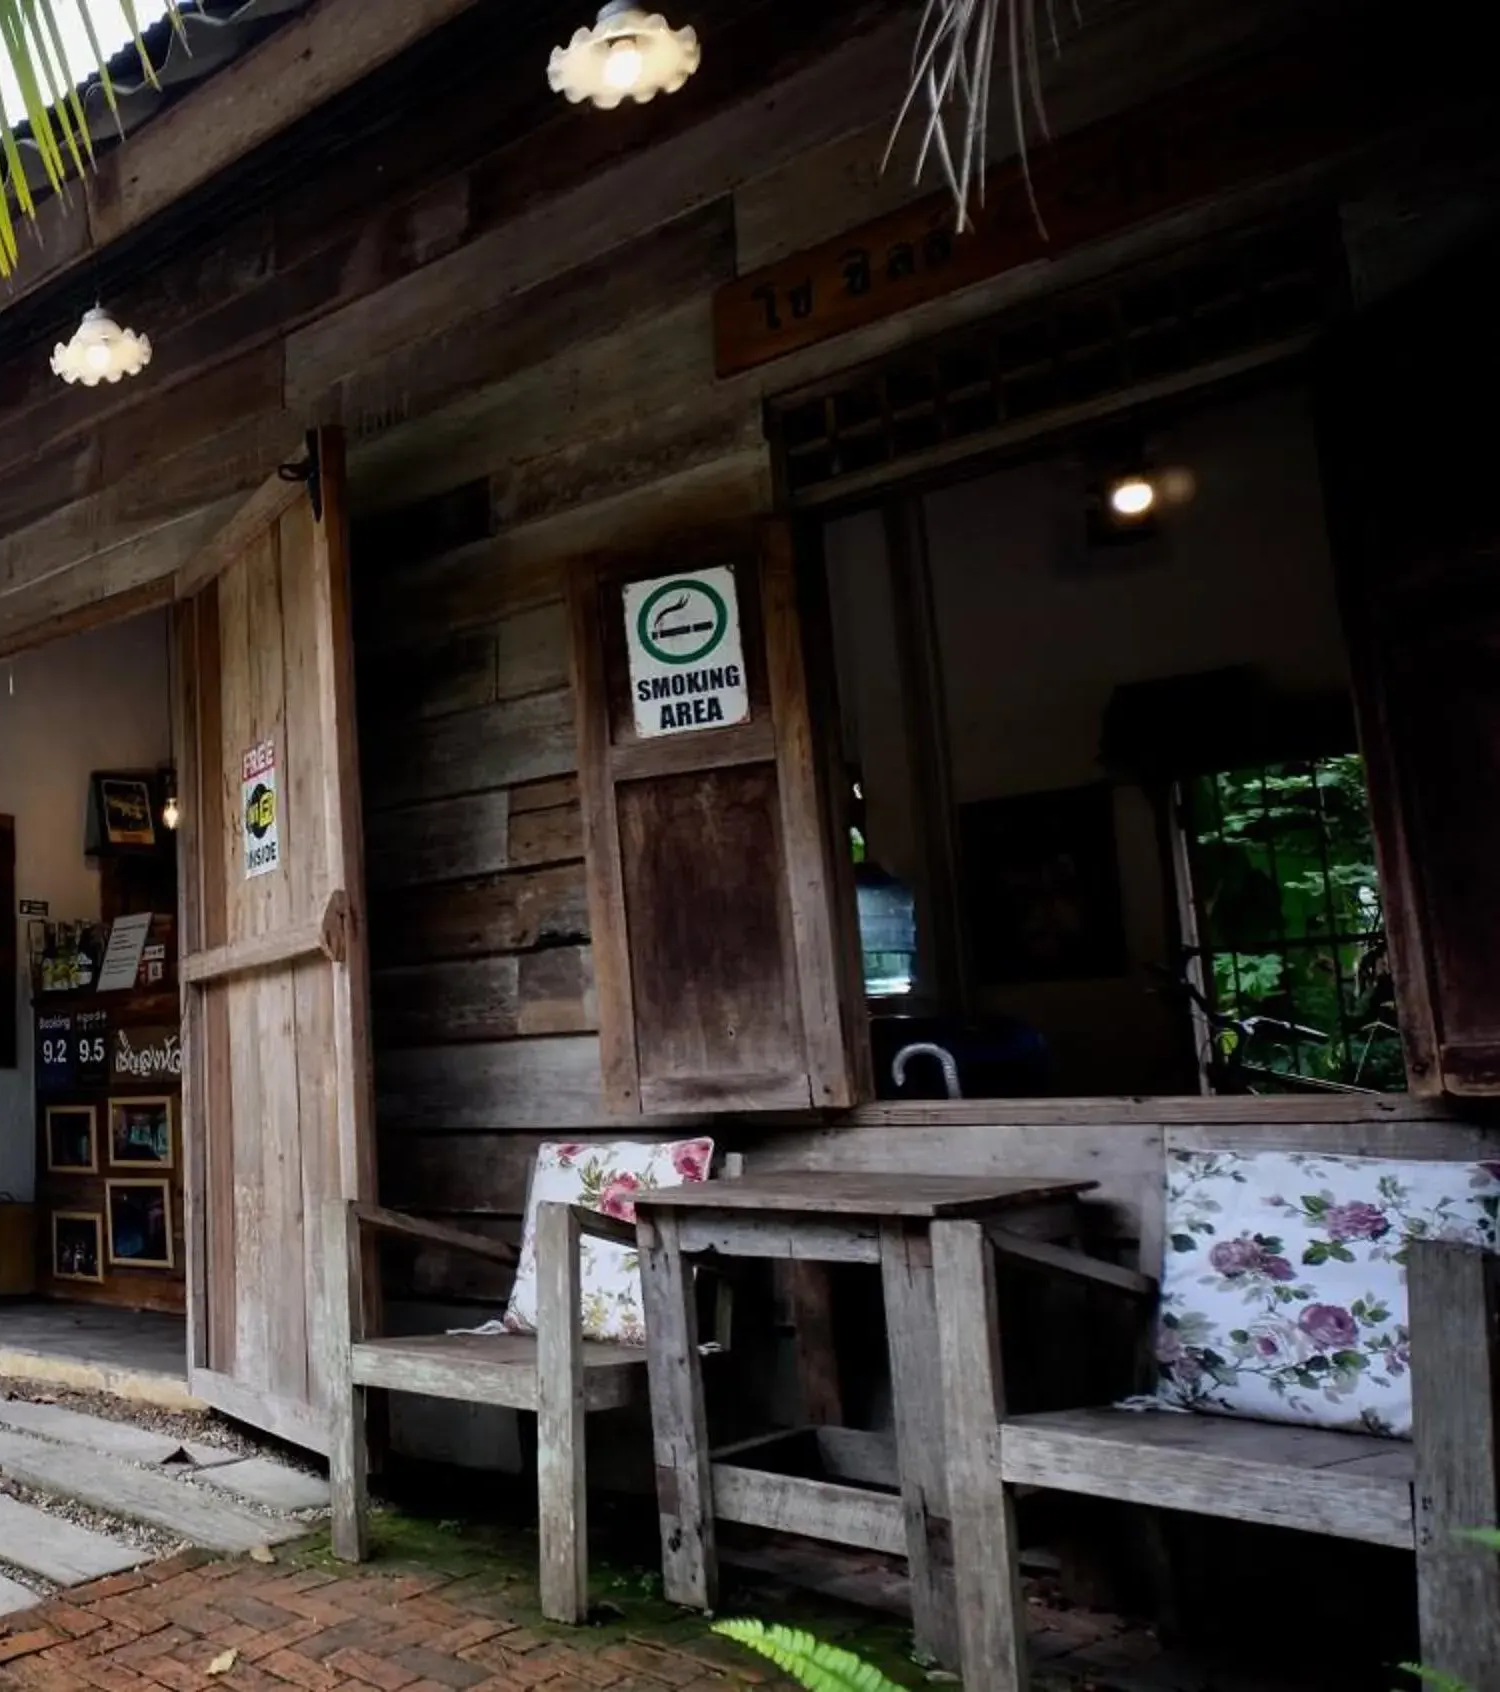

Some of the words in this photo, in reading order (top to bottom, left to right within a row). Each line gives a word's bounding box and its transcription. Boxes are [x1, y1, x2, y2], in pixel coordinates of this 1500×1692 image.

[637, 664, 740, 702] SMOKING
[660, 697, 724, 729] AREA
[243, 740, 274, 778] FREE
[248, 842, 277, 869] INSIDE
[43, 1039, 67, 1063] 9.2
[79, 1038, 105, 1063] 9.5
